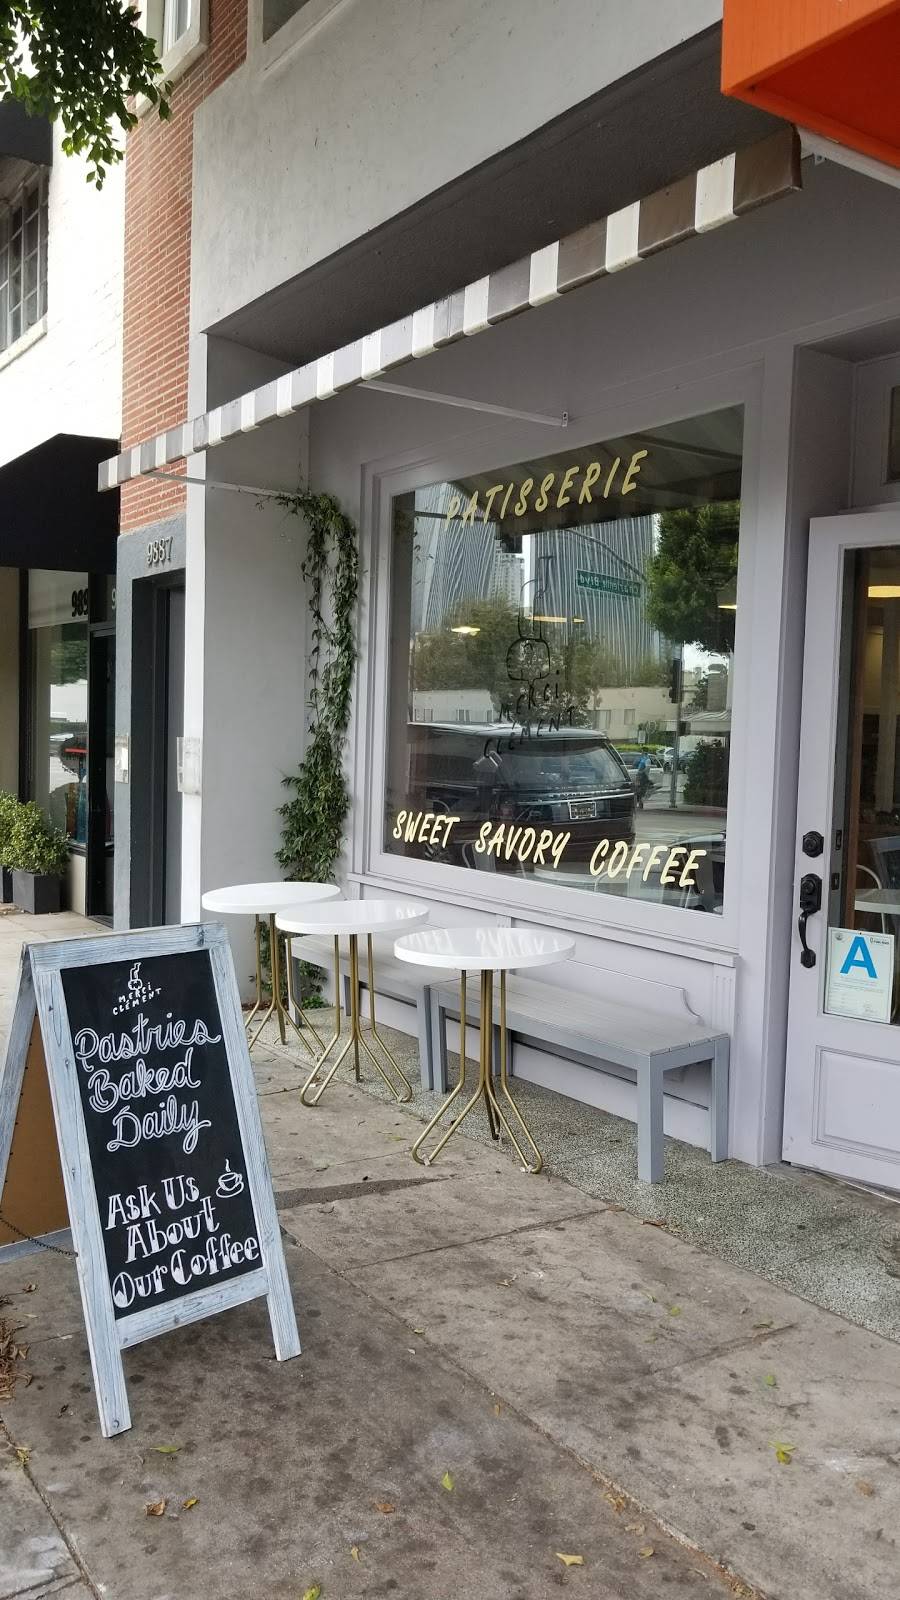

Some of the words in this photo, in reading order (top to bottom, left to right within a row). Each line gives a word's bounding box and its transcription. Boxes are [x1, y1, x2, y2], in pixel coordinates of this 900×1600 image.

[444, 450, 648, 531] PATISSERIE
[147, 536, 173, 565] 9887
[393, 810, 460, 848] SWEET
[475, 821, 571, 869] SAVORY
[589, 838, 707, 888] COFFEE
[839, 936, 878, 979] A
[74, 1012, 222, 1073] Pastries
[87, 1046, 201, 1114] Baked
[106, 1094, 212, 1155] Daily
[105, 1184, 162, 1230] Ask
[161, 1174, 200, 1210] Us
[125, 1195, 220, 1264] About
[112, 1264, 168, 1309] Our
[170, 1233, 260, 1286] Coffee
